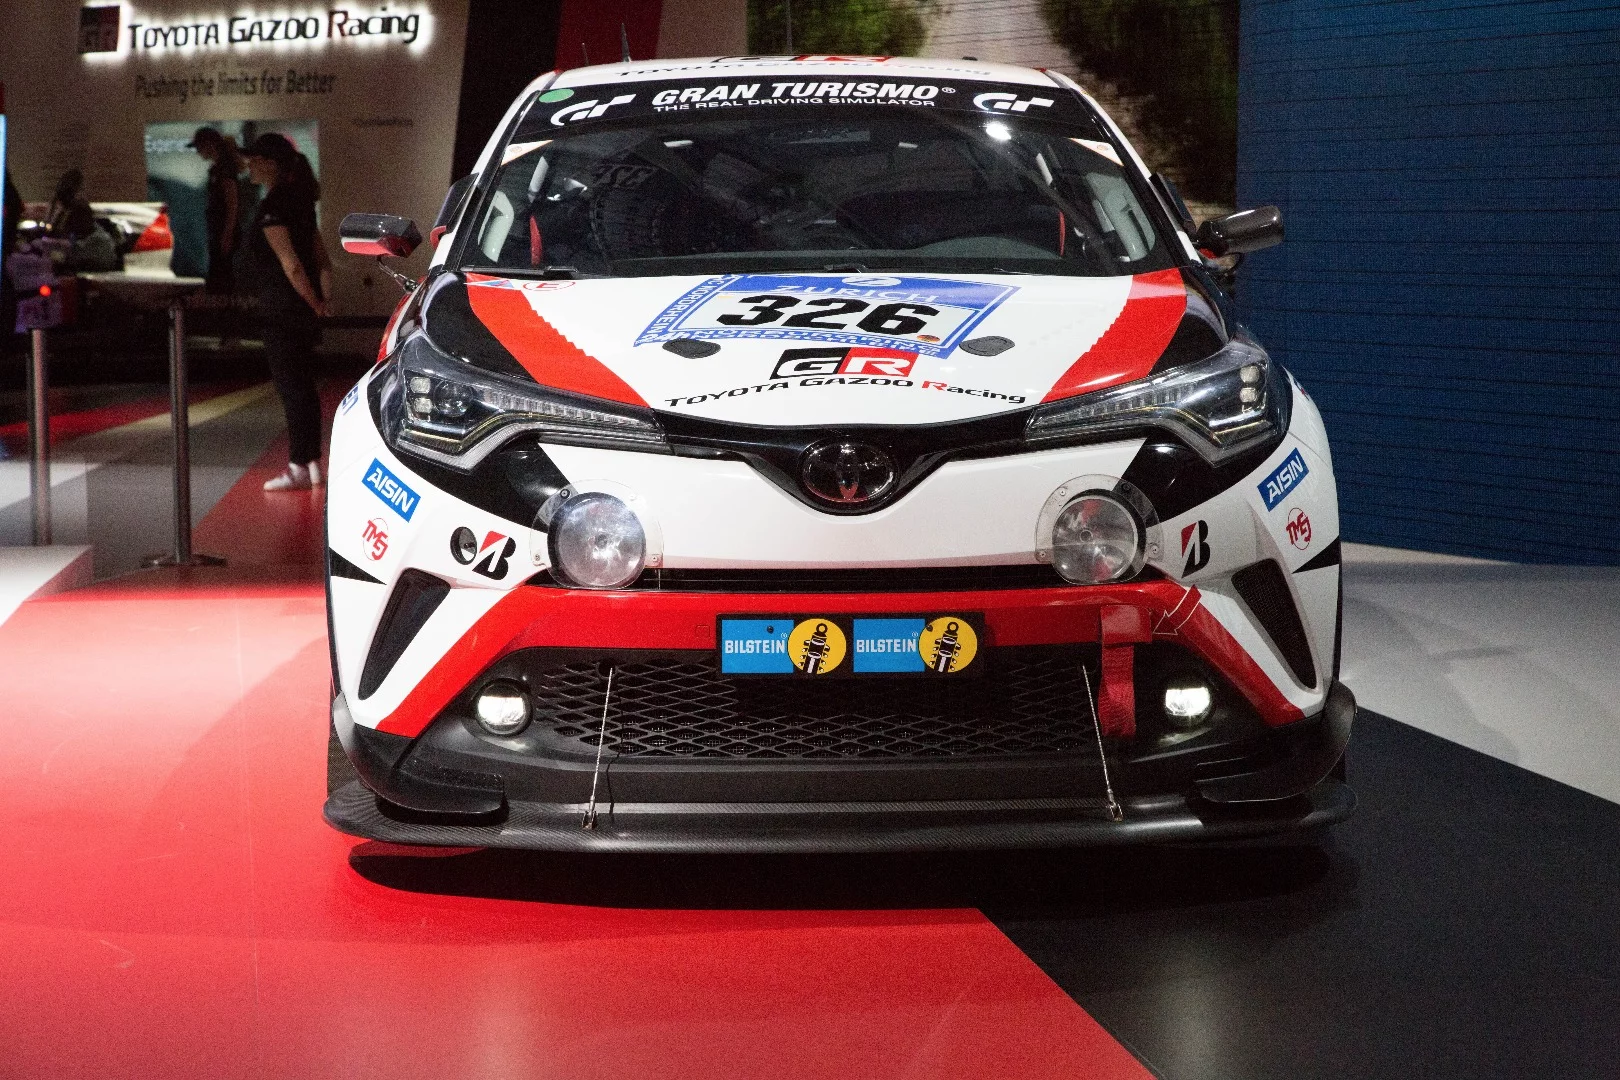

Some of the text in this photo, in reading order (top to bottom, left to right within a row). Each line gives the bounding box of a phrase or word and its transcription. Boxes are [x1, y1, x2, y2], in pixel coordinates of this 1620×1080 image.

[128, 24, 219, 49] TOYOTA
[228, 17, 319, 43] GAZOO
[327, 6, 419, 44] Racing
[218, 71, 257, 95] limits
[260, 69, 283, 95] for
[287, 69, 336, 94] Better
[652, 83, 761, 106] GRAN
[653, 97, 935, 113] THE REAL DRIVING SIMULATOR
[770, 285, 938, 303] ZURICH
[716, 295, 940, 335] 326
[664, 377, 1027, 407] TOYOTA GAZOO Racing
[366, 467, 415, 514] AISIN
[1266, 455, 1304, 504] AISIN
